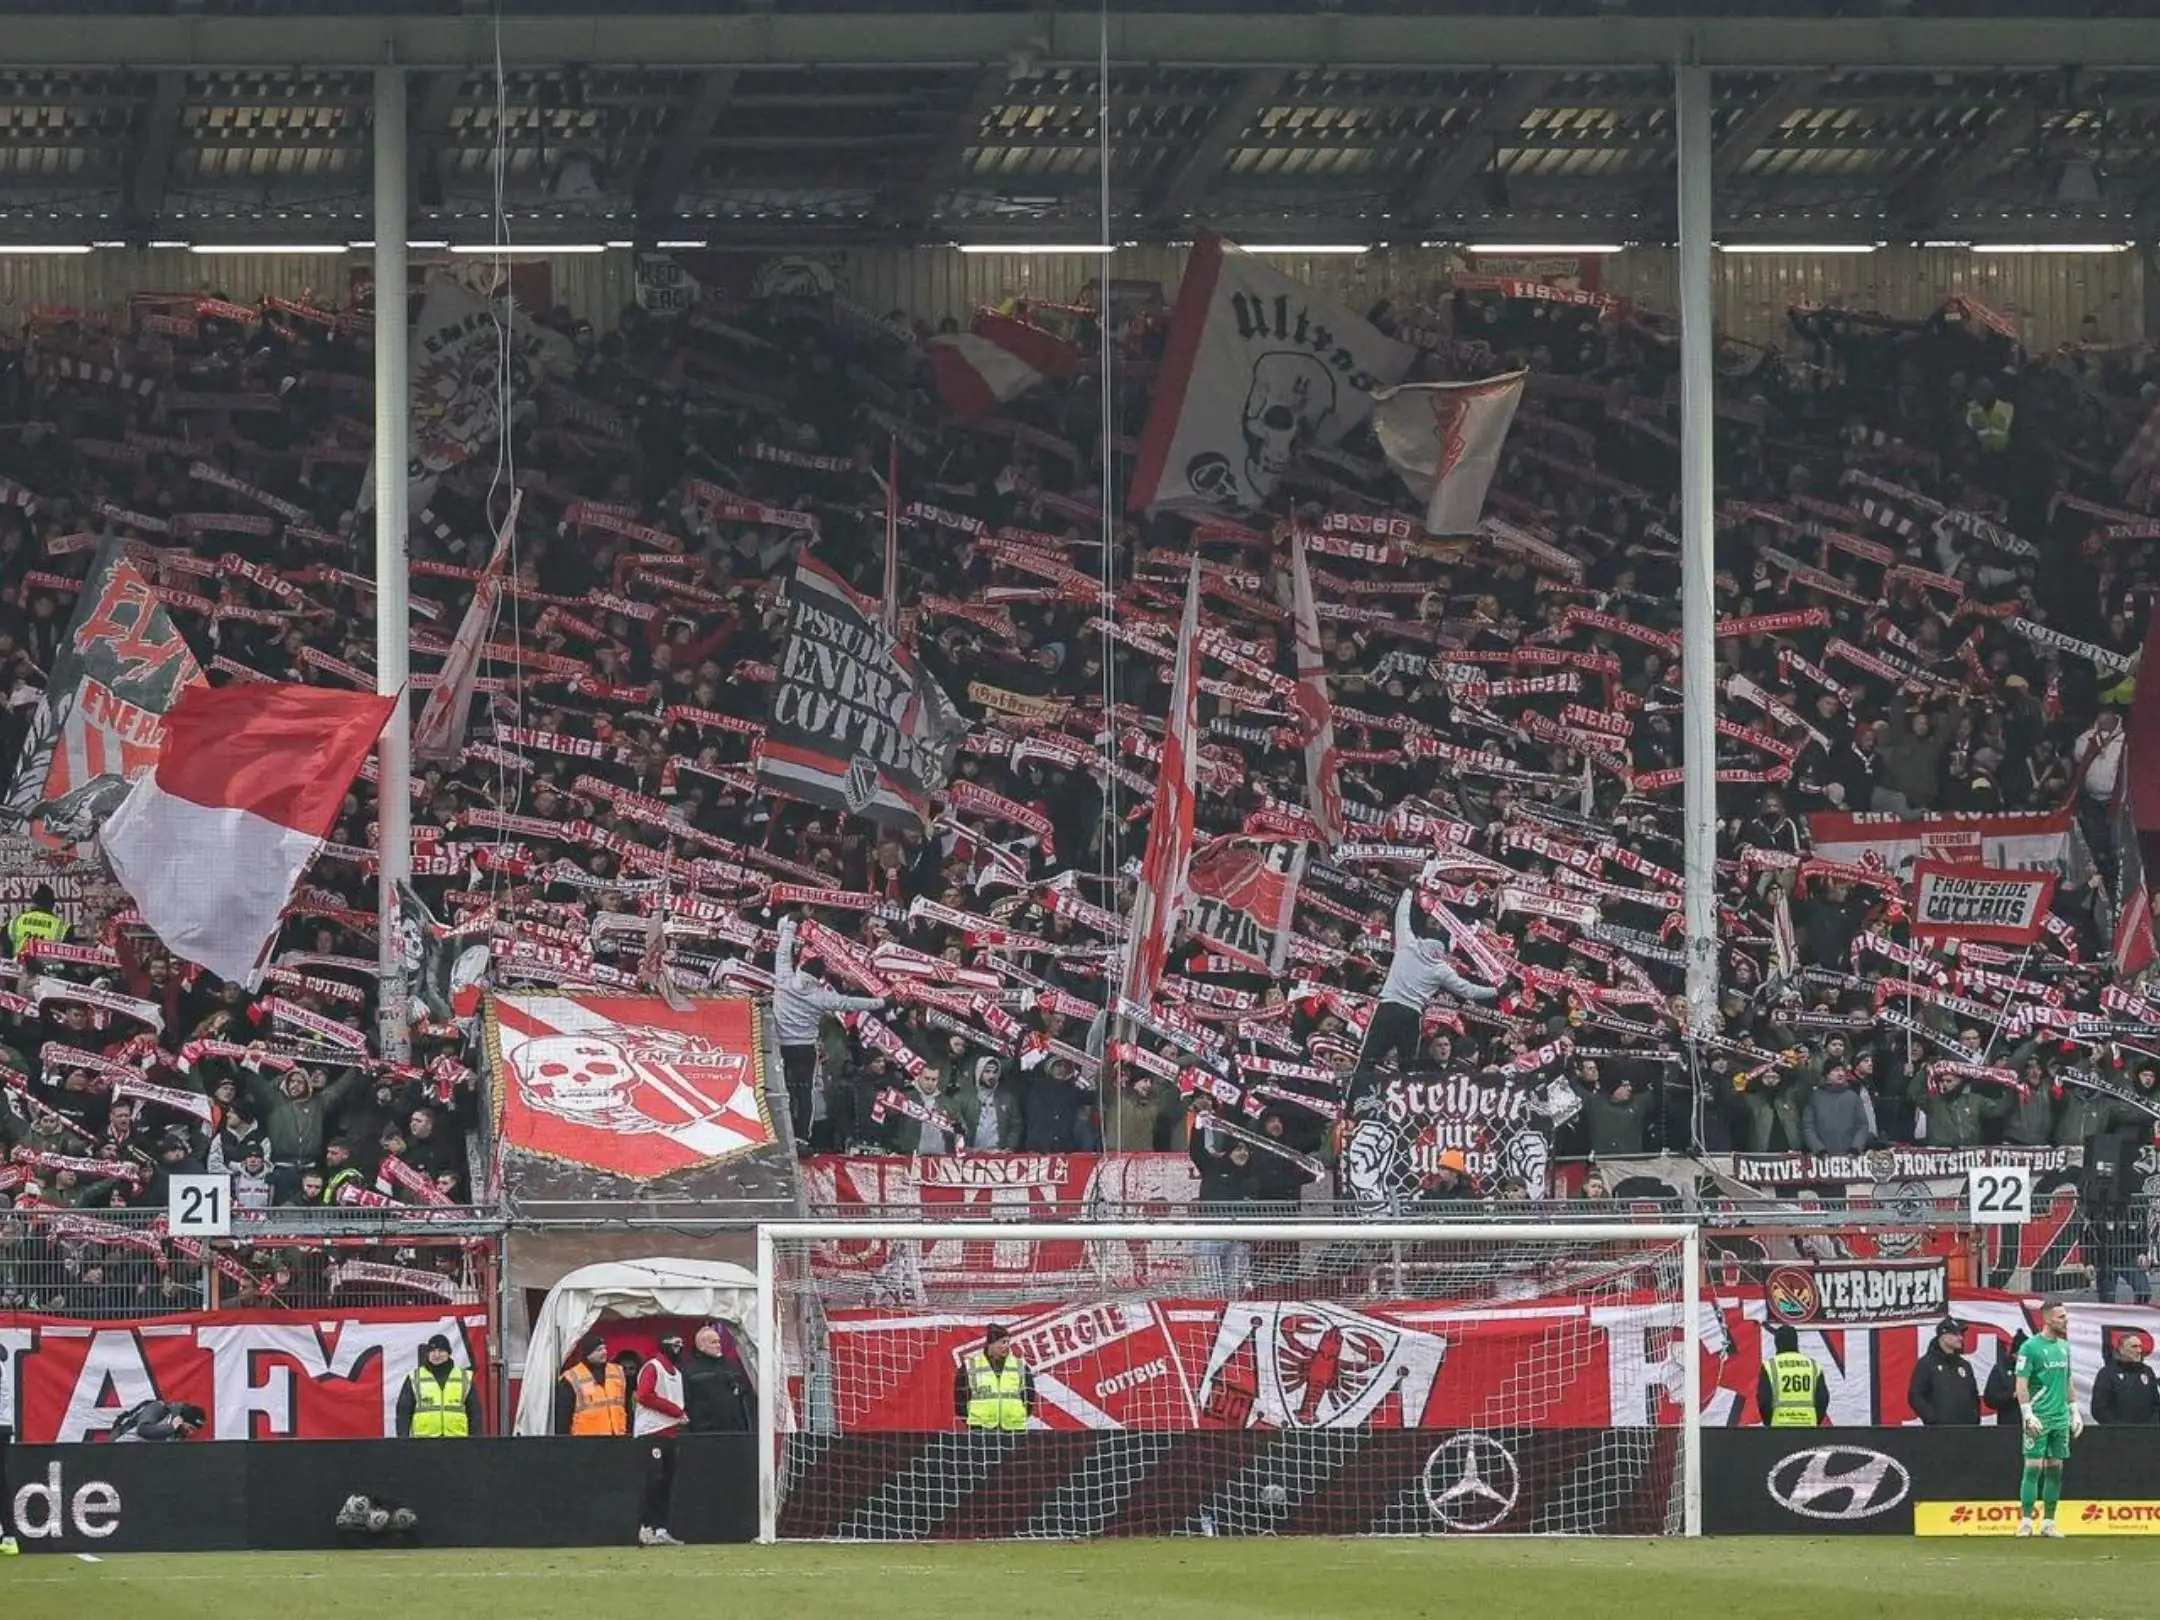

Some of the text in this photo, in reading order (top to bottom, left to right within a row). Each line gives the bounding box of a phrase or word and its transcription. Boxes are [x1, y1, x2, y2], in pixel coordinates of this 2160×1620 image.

[1932, 876, 2032, 898] FRONTSIDE
[1925, 895, 2025, 925] COTTBUS
[1384, 1075, 1527, 1123] Freiheit
[1435, 1118, 1481, 1151] für
[1409, 1143, 1498, 1175] Ulas
[1737, 1148, 2066, 1182] AKTIVE JUGEN FRONTSIDE COTTBUS
[180, 1186, 221, 1225] 21
[1976, 1174, 2024, 1212] 22
[1814, 1266, 1946, 1308] VERBOTEN
[1009, 1300, 1130, 1369] NERGIE
[1095, 1358, 1168, 1399] COTTBUS
[1781, 1374, 1811, 1393] 260
[12, 1460, 122, 1538] de
